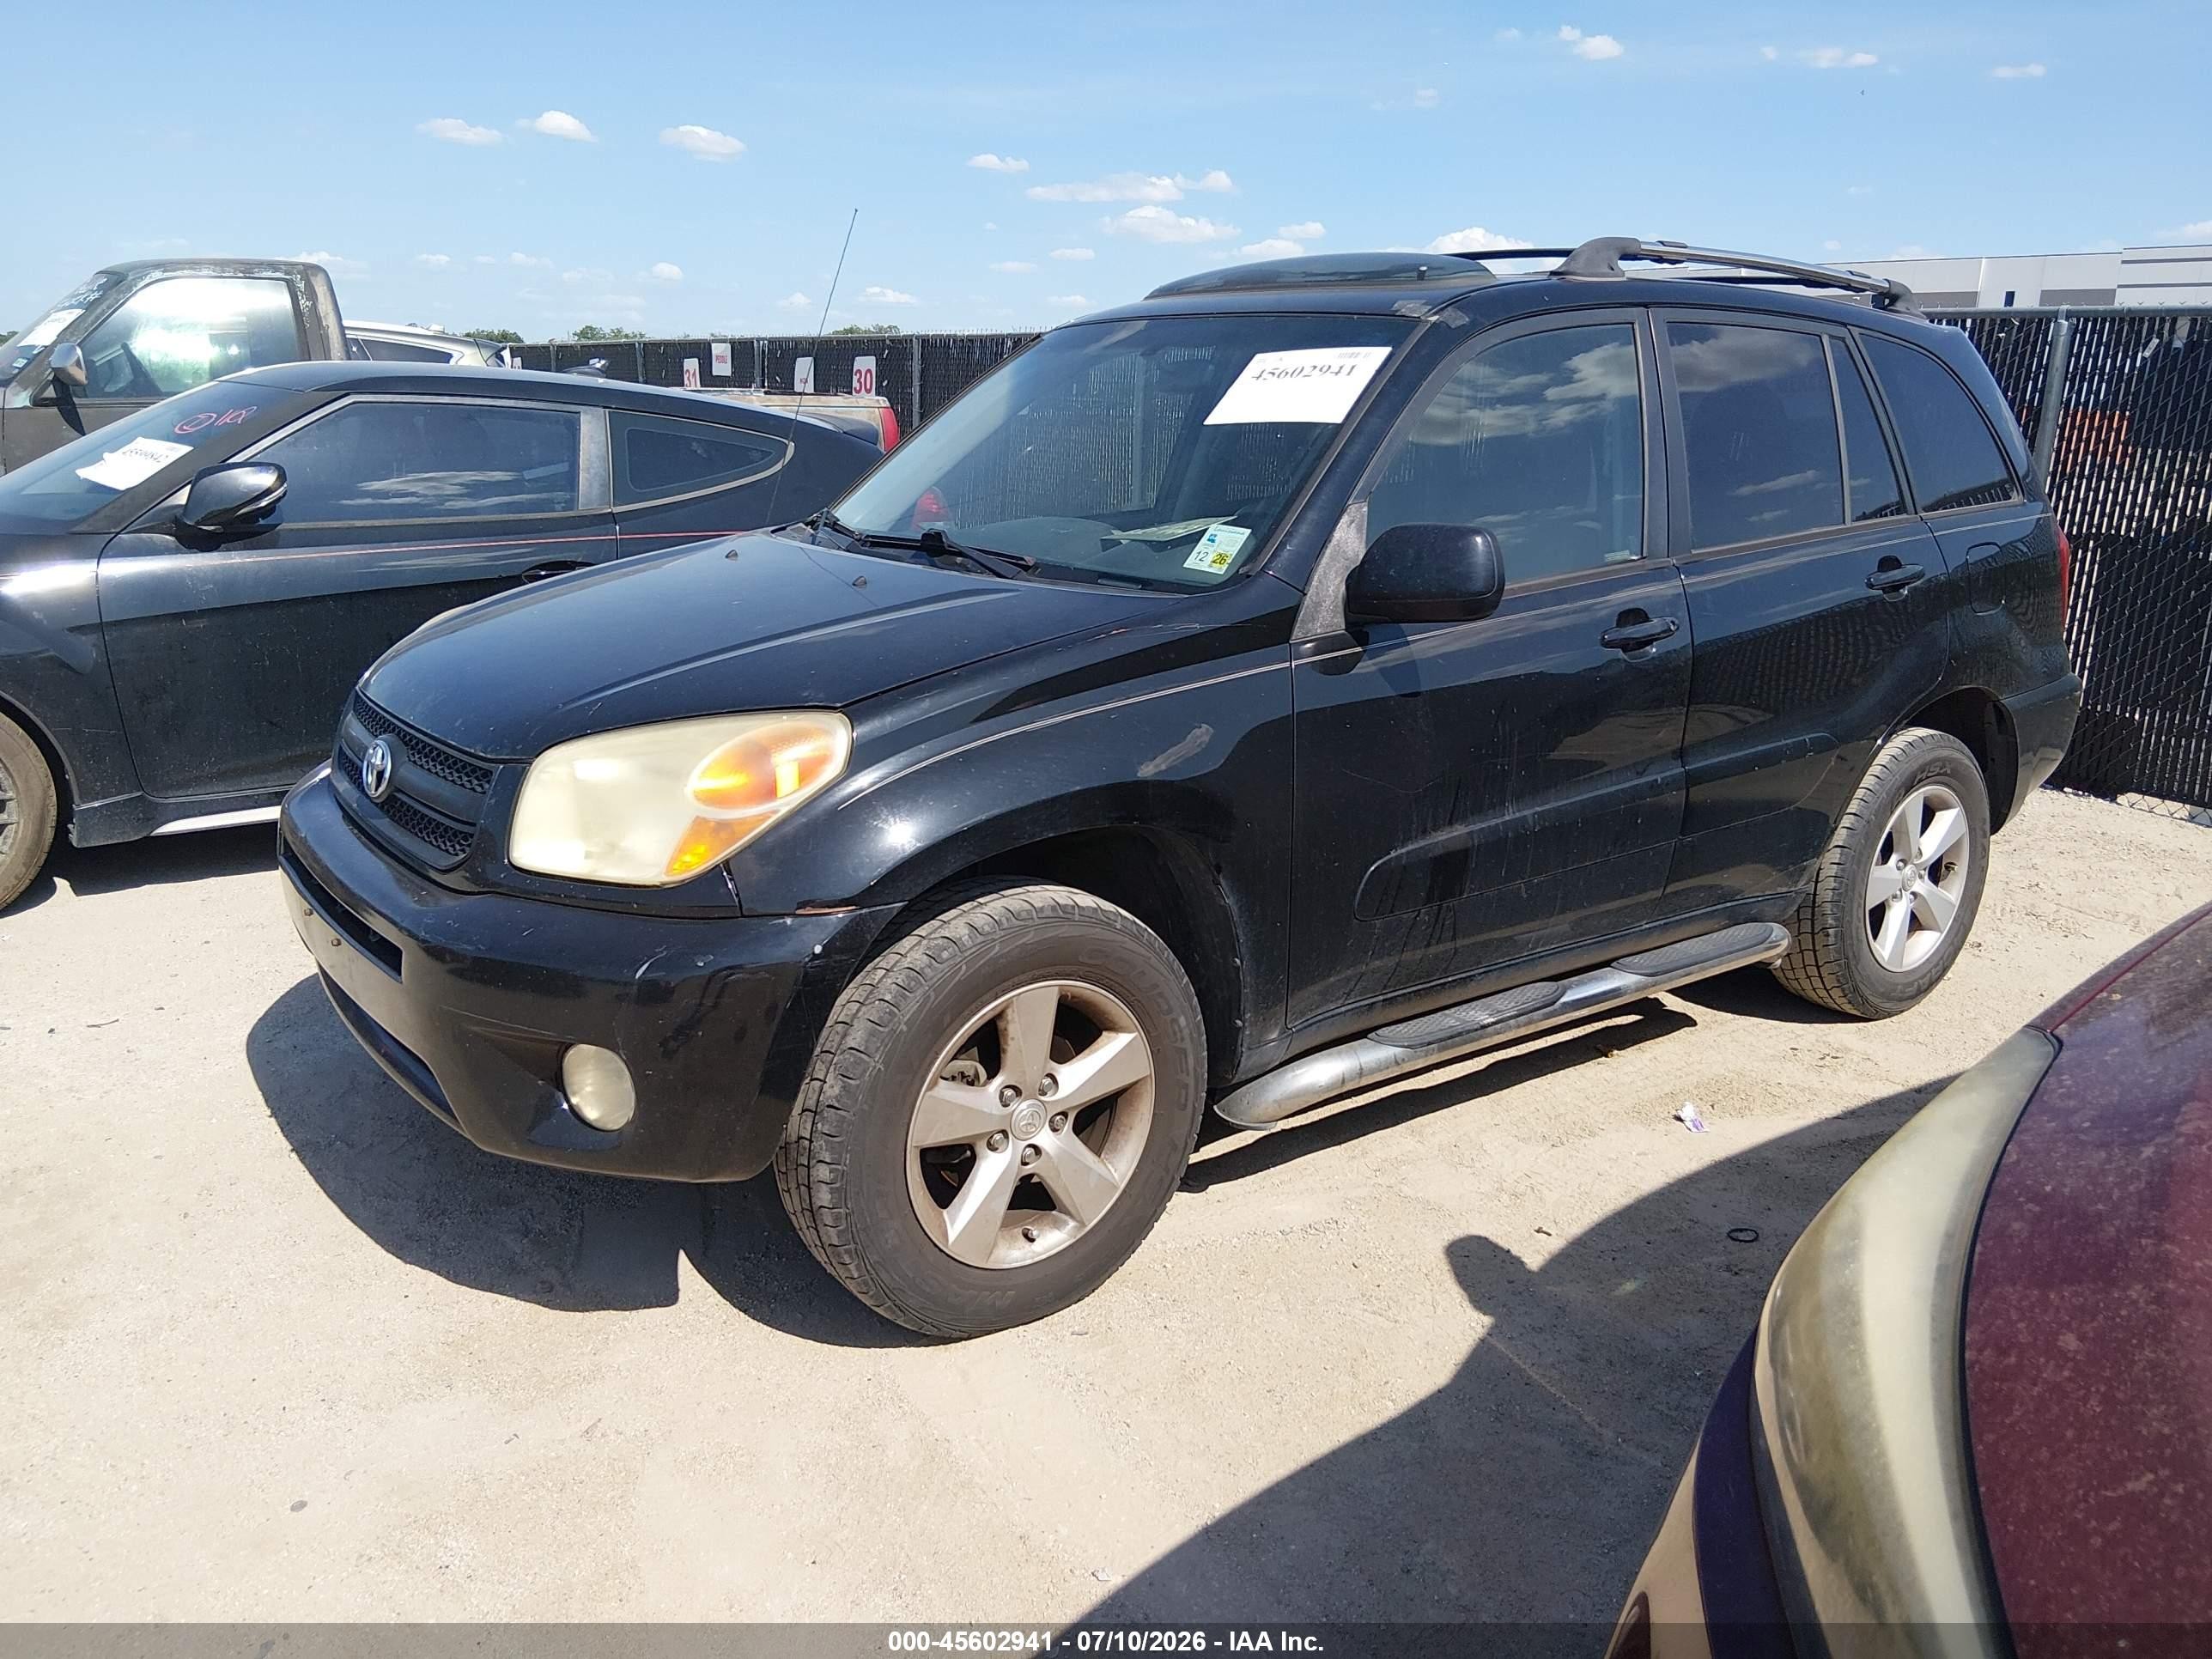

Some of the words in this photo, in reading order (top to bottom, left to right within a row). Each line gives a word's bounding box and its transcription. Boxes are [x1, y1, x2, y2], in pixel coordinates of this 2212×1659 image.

[684, 368, 698, 387] 31
[854, 368, 874, 394] 30
[1251, 363, 1358, 381] 45602941
[1194, 550, 1209, 562] 12
[1212, 552, 1229, 566] 26
